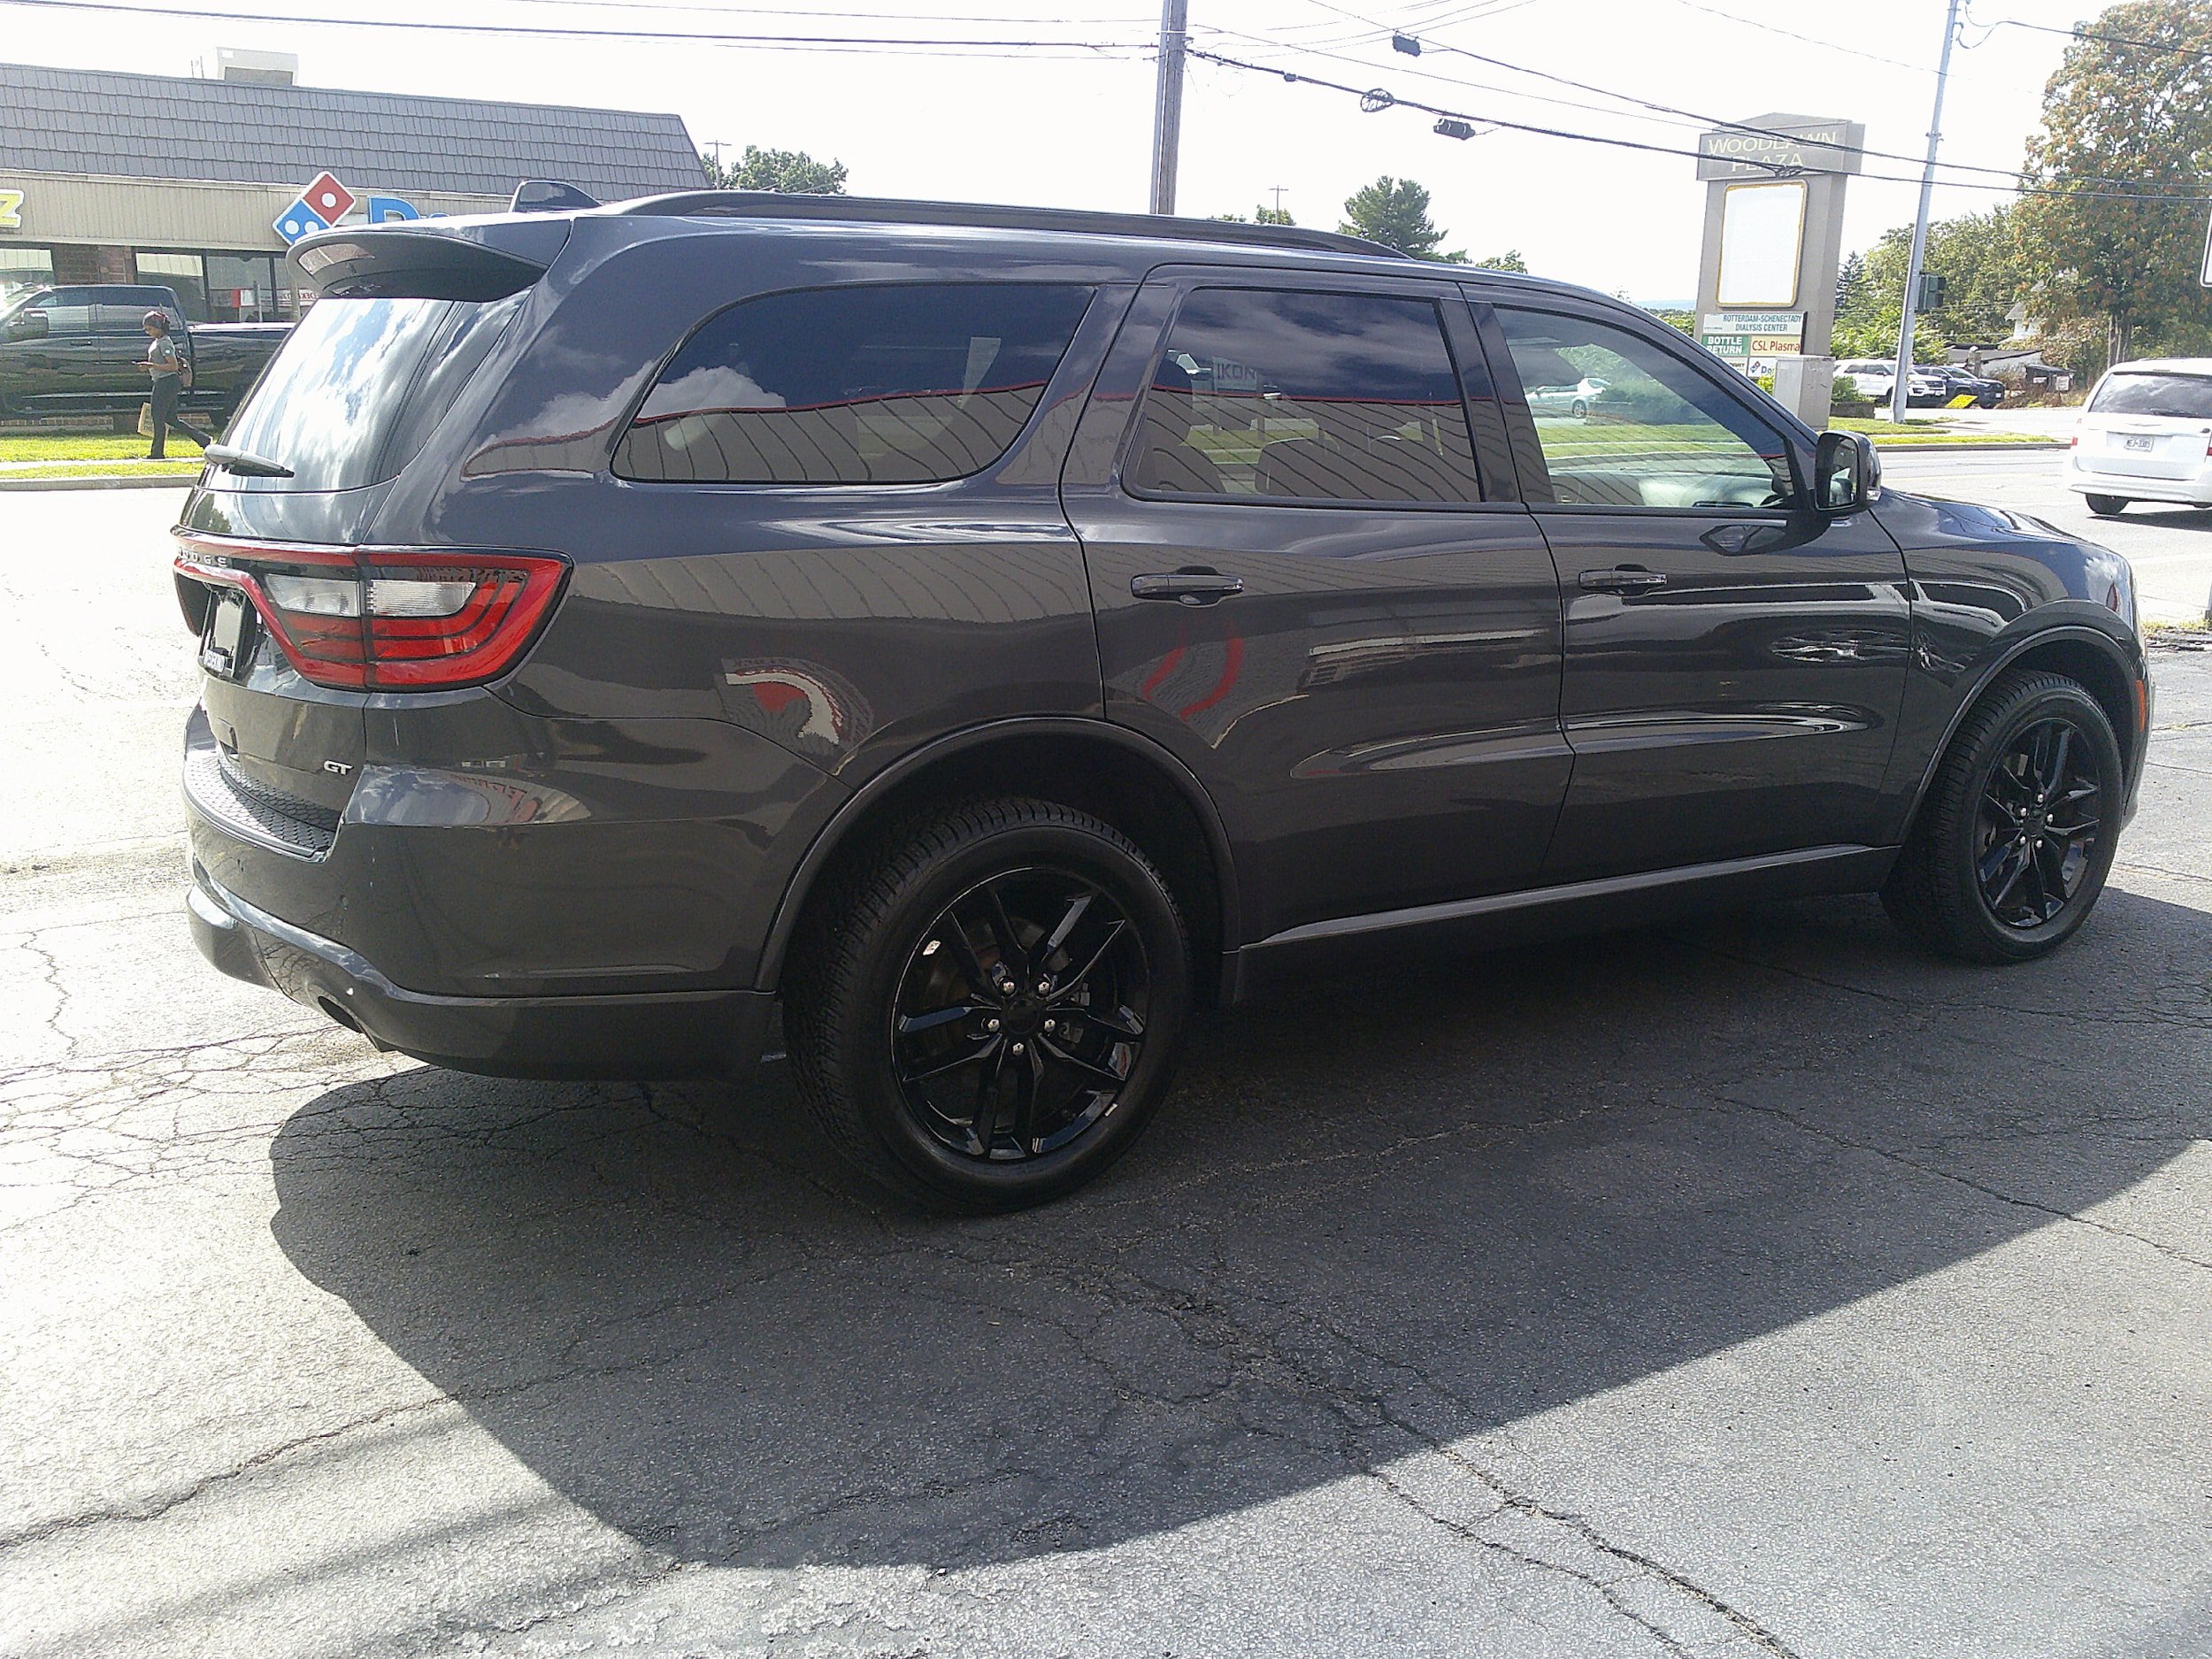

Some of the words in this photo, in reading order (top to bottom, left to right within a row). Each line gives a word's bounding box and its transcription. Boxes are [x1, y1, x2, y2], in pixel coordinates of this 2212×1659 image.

[1723, 314, 1801, 323] ROTTERDAM-SCHENECTADY
[1708, 336, 1742, 345] BOTTLE
[1707, 345, 1742, 354] RETURN
[1752, 340, 1767, 351] CSL
[1770, 341, 1801, 351] Plasma
[323, 760, 354, 775] GT
